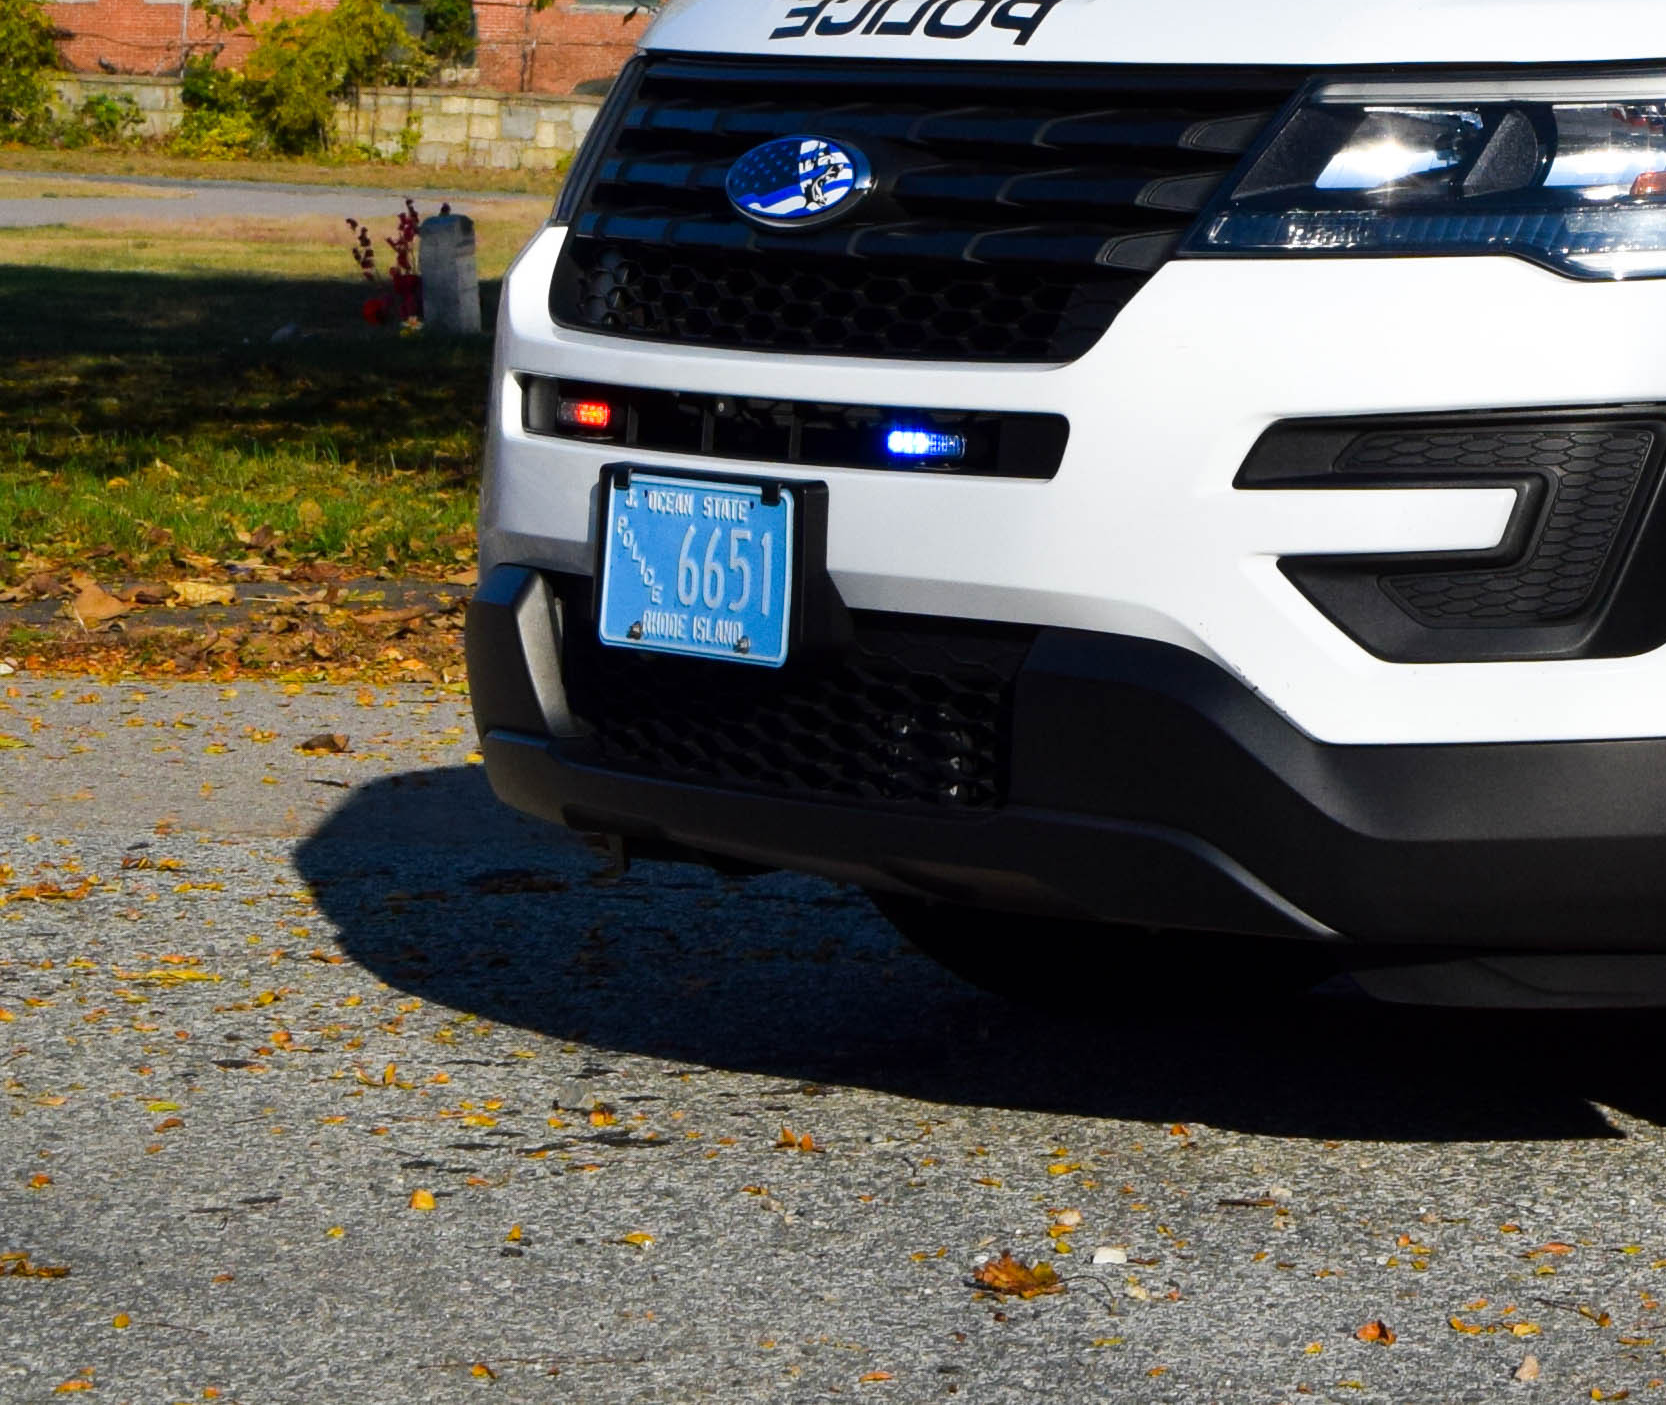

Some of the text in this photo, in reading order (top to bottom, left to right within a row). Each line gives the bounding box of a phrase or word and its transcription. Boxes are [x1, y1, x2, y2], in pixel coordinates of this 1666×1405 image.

[647, 490, 748, 522] OCEAN STATE
[617, 515, 663, 605] POLICE
[677, 524, 773, 617] 6651
[641, 610, 743, 647] RHODE ISLAND
